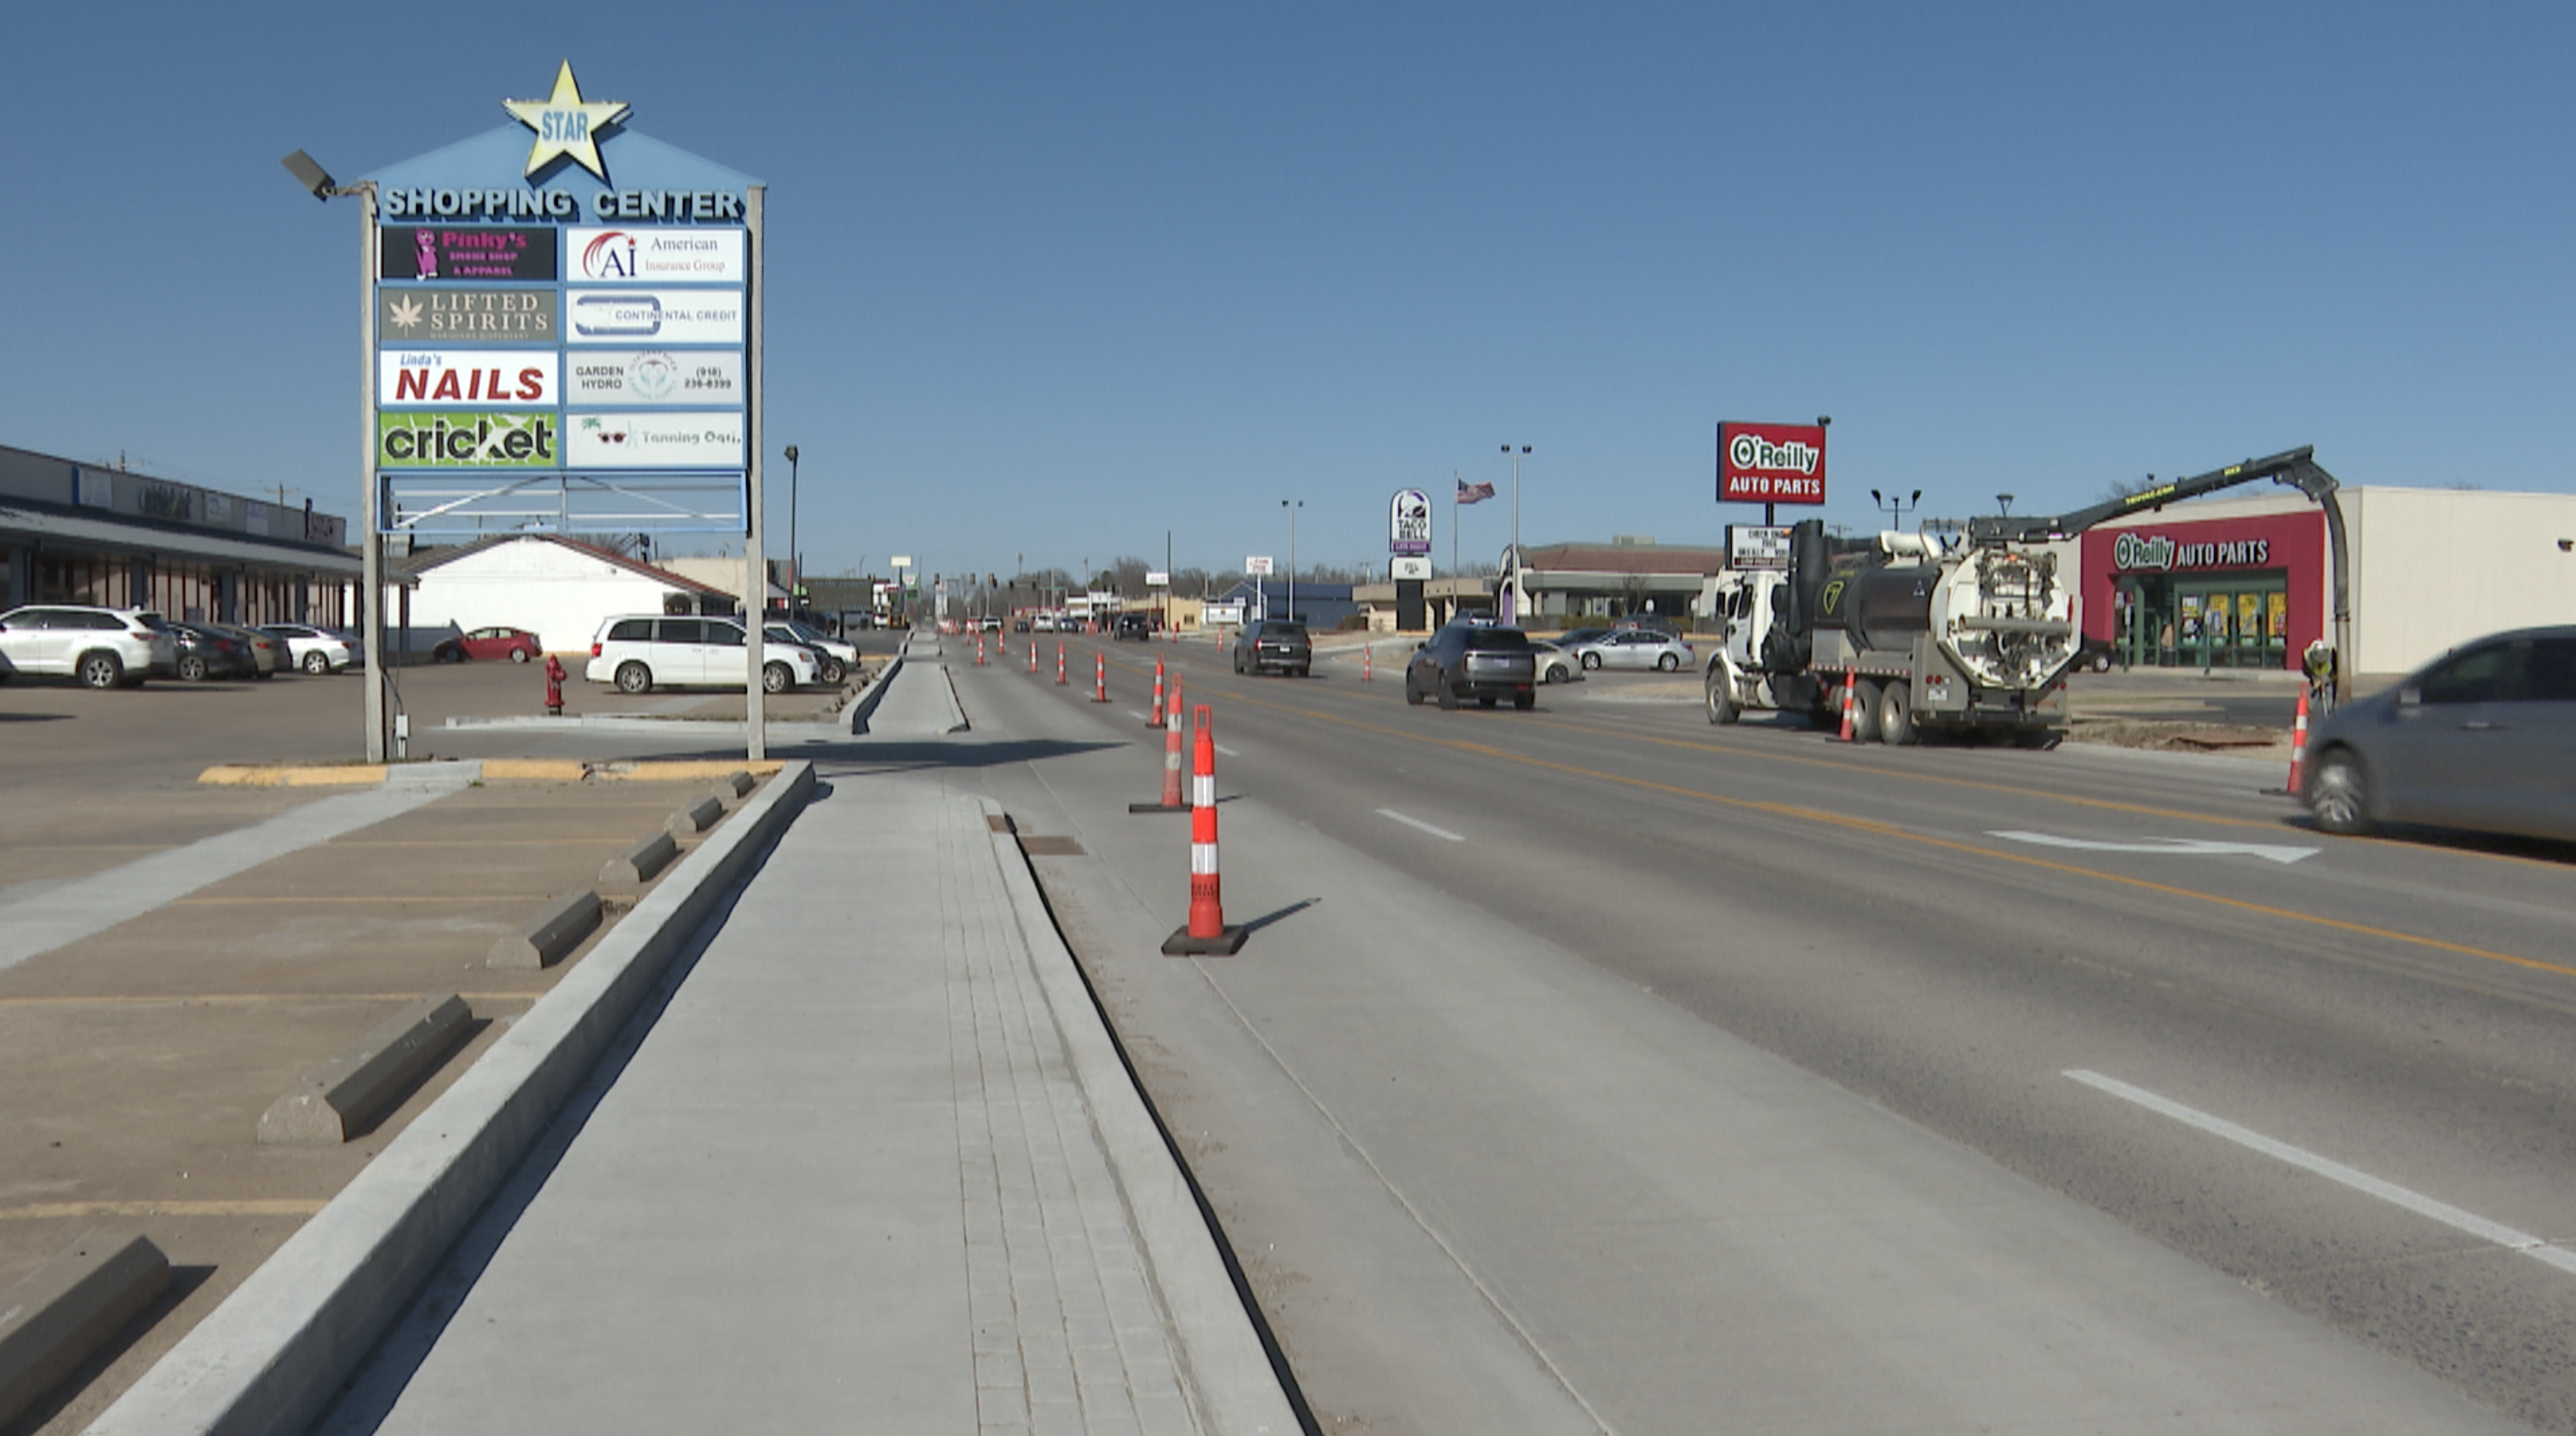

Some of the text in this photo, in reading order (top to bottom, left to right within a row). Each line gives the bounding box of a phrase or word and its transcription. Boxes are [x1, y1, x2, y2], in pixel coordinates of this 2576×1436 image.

[542, 111, 589, 142] STAR
[384, 187, 739, 217] SHOPPING CENTER
[441, 232, 526, 250] Pinky's
[651, 237, 718, 251] American
[488, 251, 518, 261] SHOP
[463, 267, 513, 275] APPAREL
[645, 259, 726, 273] Insurance Group
[431, 293, 538, 312] LIFTED
[431, 313, 549, 331] SPIRITS
[615, 310, 738, 321] CONTINENTAL CREDIT
[400, 353, 442, 366] Linda's
[576, 365, 624, 376] GARDEN
[695, 366, 722, 378] (918)
[395, 368, 544, 400] NAILS
[581, 378, 623, 389] HYDRO
[385, 419, 554, 460] cricket
[642, 430, 700, 445] Tanning
[1731, 434, 1820, 474] O'Reilly
[1729, 476, 1820, 495] AUTO PARTS
[1397, 520, 1427, 529] TACO
[1399, 529, 1426, 539] BELL
[2114, 533, 2268, 571] O'Reilly AUTO PARTS
